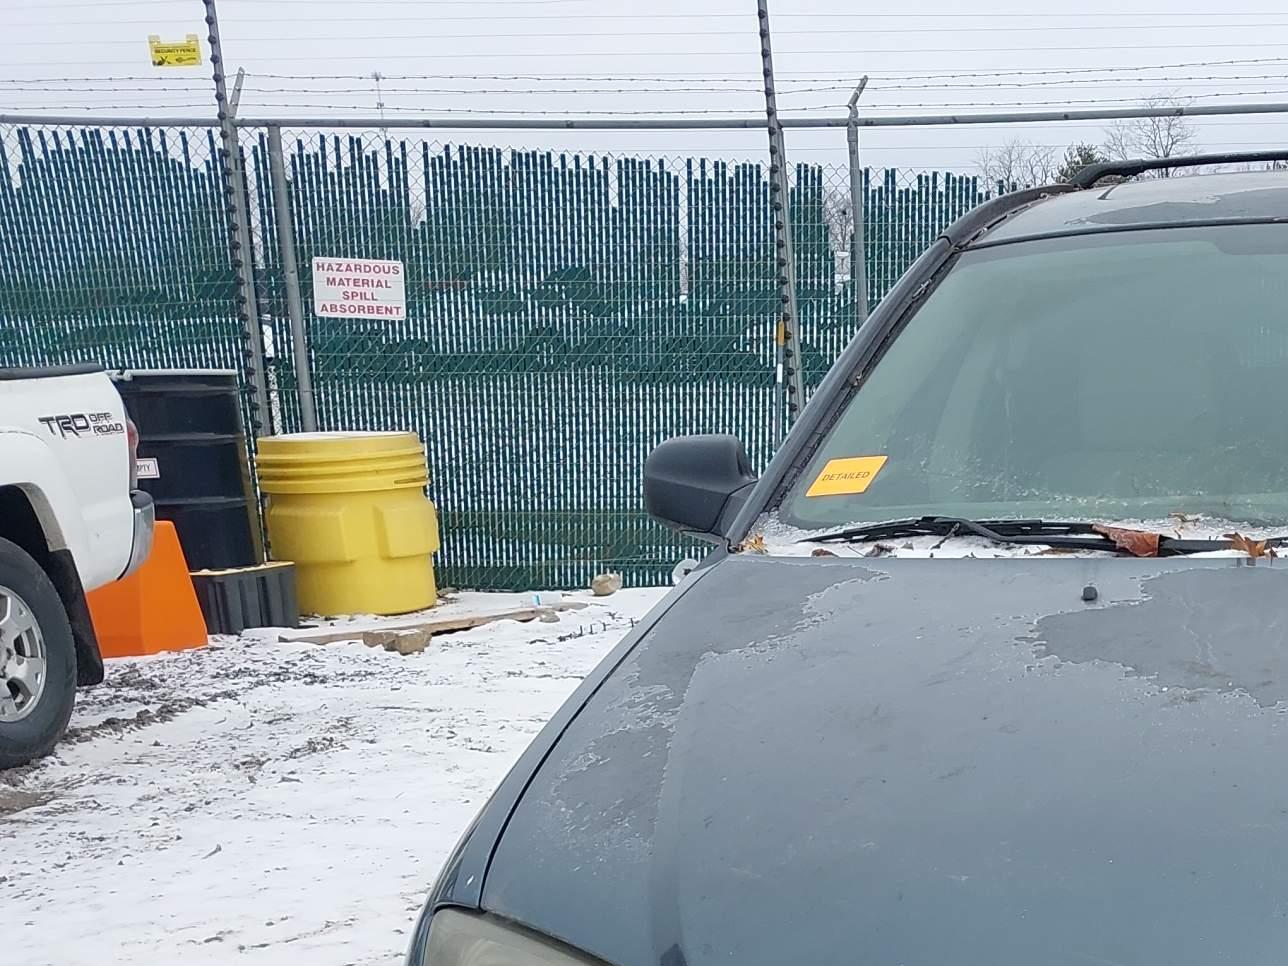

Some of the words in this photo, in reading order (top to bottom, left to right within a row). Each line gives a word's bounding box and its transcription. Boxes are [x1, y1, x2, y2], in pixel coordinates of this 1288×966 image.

[316, 262, 400, 275] HAZARDOUS
[326, 277, 392, 289] MATERIAL
[342, 291, 379, 301] SPILL
[320, 303, 402, 315] ABSORBENT
[38, 413, 90, 440] TRD
[89, 412, 112, 423] OFF
[93, 423, 125, 435] ROAD
[822, 471, 870, 481] DETAILED
